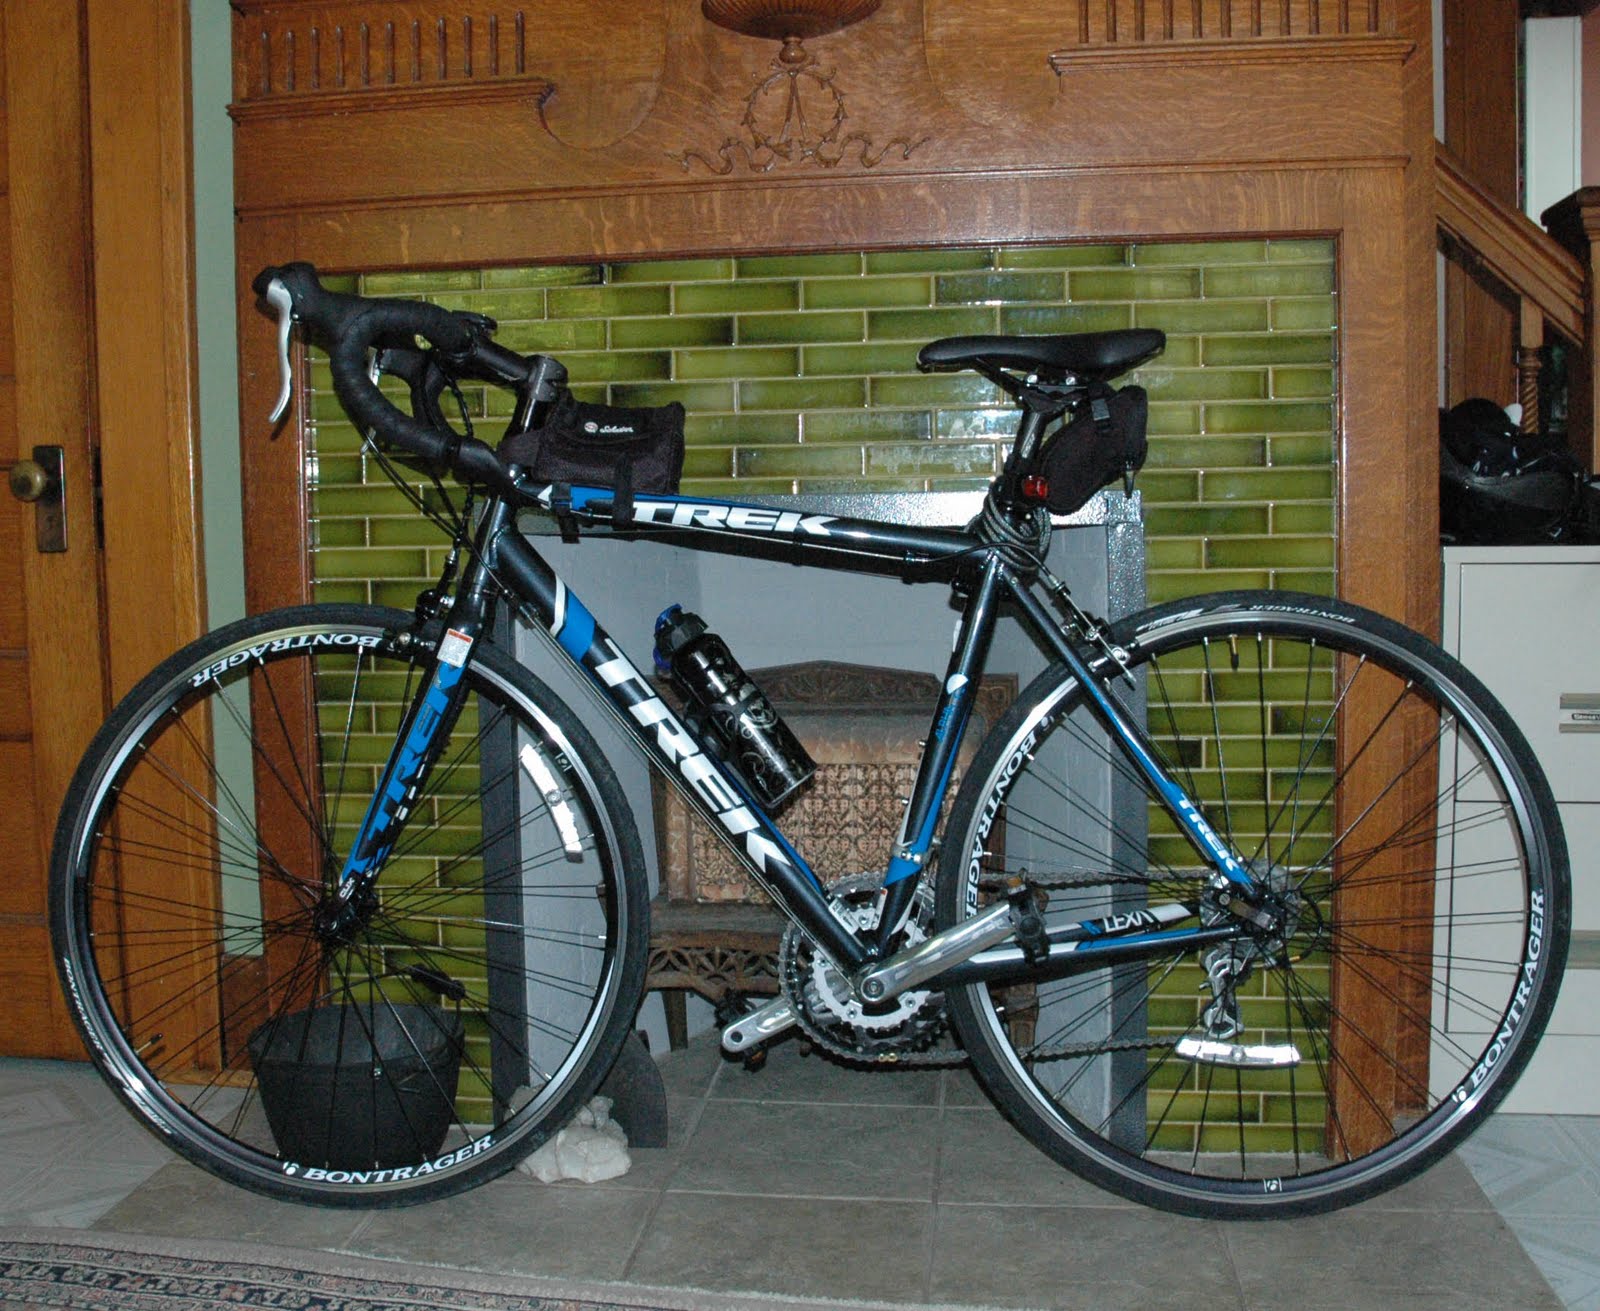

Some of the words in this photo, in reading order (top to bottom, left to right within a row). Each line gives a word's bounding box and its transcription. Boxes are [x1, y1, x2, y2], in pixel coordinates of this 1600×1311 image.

[632, 501, 840, 536] TREK
[1249, 604, 1355, 625] BONTRAGER
[193, 634, 384, 688] BONTRAGER
[368, 661, 465, 839] TREK
[595, 638, 791, 873] TREK
[1178, 793, 1237, 871] TREK
[1471, 890, 1544, 1088] BONTRAGER
[302, 1135, 494, 1183] BONTRAGER
